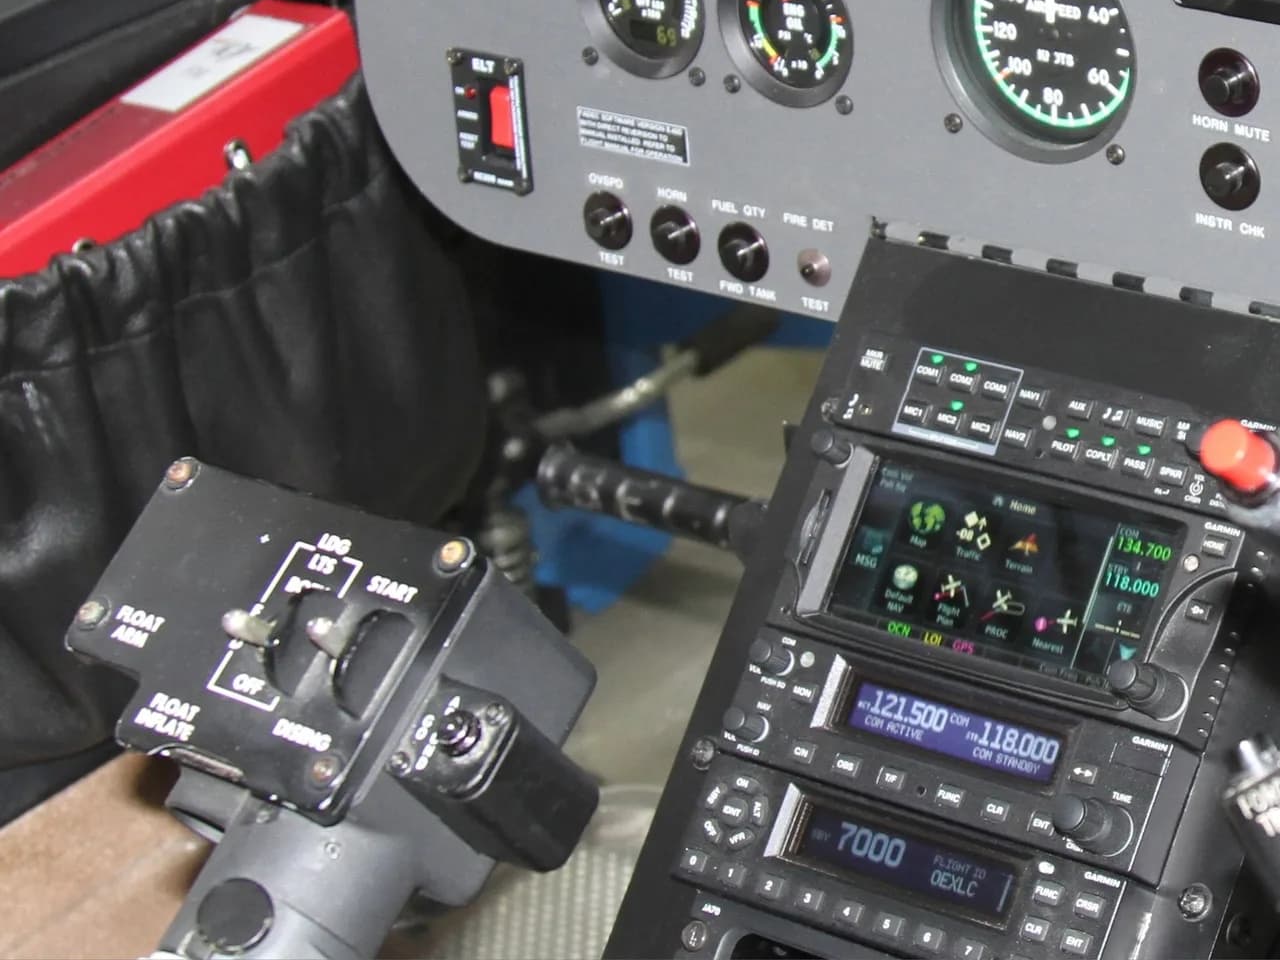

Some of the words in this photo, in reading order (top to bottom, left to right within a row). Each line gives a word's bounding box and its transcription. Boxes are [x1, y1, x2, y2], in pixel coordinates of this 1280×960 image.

[1087, 7, 1110, 24] 40
[993, 22, 1017, 40] 120
[472, 58, 495, 74] ELT
[1007, 56, 1032, 76] 100
[1088, 68, 1109, 85] 60
[1043, 87, 1063, 106] 80
[1192, 114, 1228, 132] HORN
[1234, 123, 1270, 141] MUTE
[588, 172, 624, 188] OVSPD
[657, 188, 687, 202] HORN
[712, 200, 738, 214] FUEL
[743, 206, 765, 218] QTY
[783, 213, 808, 227] FIRE
[812, 219, 834, 232] DET
[1195, 213, 1232, 231] INSTR
[1239, 222, 1265, 238] CHK
[600, 252, 624, 265] TEST
[667, 268, 693, 281] TEST
[720, 280, 743, 294] FWD
[750, 285, 776, 300] TANK
[802, 297, 829, 311] TEST
[916, 365, 939, 376] COM1
[904, 405, 923, 416] MIC1
[1010, 500, 1037, 515] Home
[1204, 522, 1240, 536] GARMIN
[317, 534, 351, 555] LDG
[1117, 537, 1171, 562] 134.700
[307, 553, 337, 574] LTS
[855, 554, 878, 568] MSG
[366, 575, 418, 603] START
[1105, 572, 1159, 598] 118.000
[116, 605, 165, 633] FLOAT
[111, 624, 149, 648] ARM
[953, 640, 975, 654] GPS
[232, 673, 265, 694] OFF
[150, 692, 200, 721] FLOAT
[870, 691, 949, 732] 121.500
[134, 708, 195, 741] INFLATE
[865, 717, 884, 730] COM
[886, 723, 924, 740] ACTIVE
[978, 722, 1060, 764] 118.000
[1132, 736, 1169, 751] GARMIN
[973, 748, 992, 761] COM
[996, 753, 1040, 774] STANDBY
[1112, 792, 1133, 803] TUNE
[987, 804, 1004, 815] CLR
[1033, 819, 1050, 830] ENT
[838, 821, 907, 867] 7000
[934, 855, 971, 873] FLIGHT
[974, 867, 986, 879] ID
[930, 871, 978, 897] OEXLC
[1084, 872, 1121, 888] GARMIN
[1036, 887, 1058, 900] FUNC
[1025, 924, 1042, 934] CLR
[1066, 937, 1084, 947] ENT
